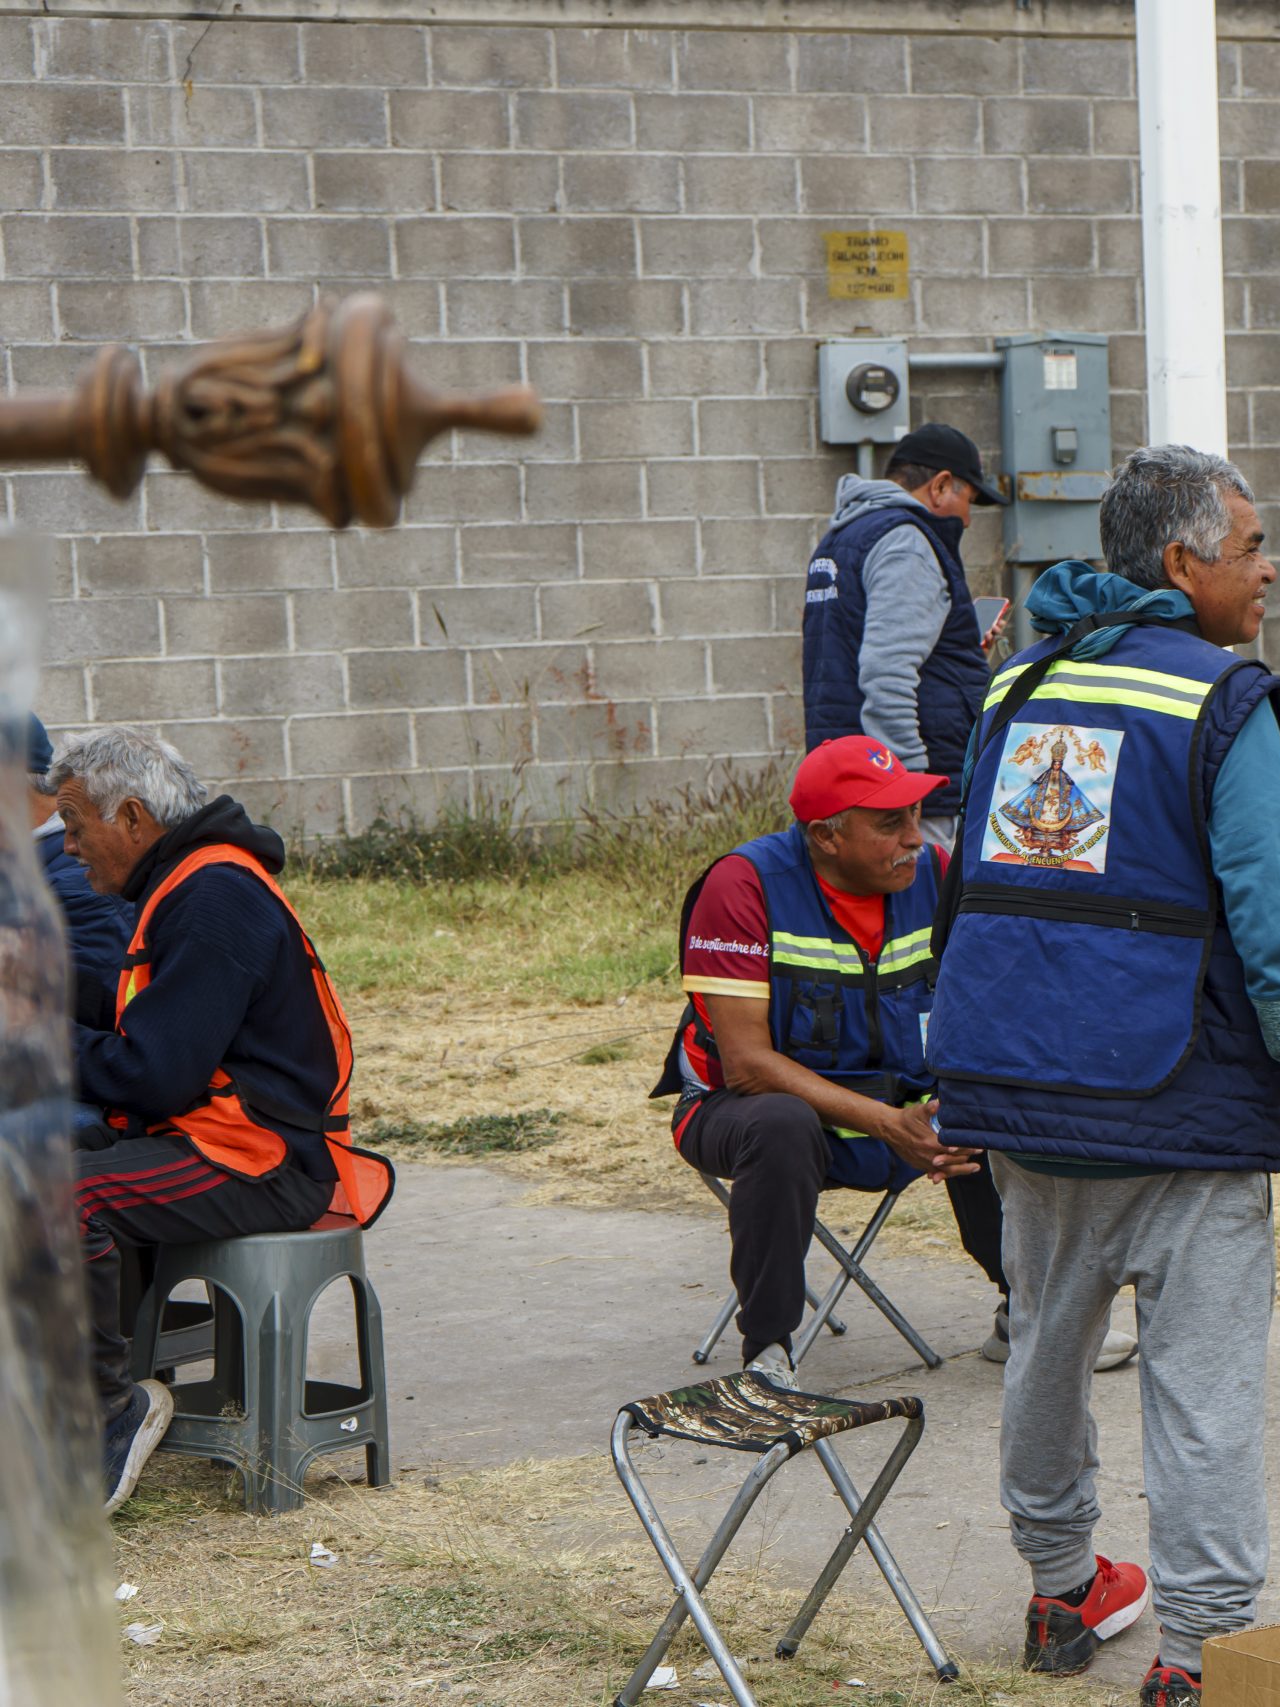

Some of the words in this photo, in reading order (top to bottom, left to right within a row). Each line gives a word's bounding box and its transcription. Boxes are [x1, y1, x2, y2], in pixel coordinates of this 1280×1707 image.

[989, 811, 1021, 855] PEREGRINOS
[1031, 852, 1074, 865] ENCUENTRO
[1073, 844, 1087, 857] DE
[702, 937, 749, 954] septiembre
[750, 941, 763, 955] de
